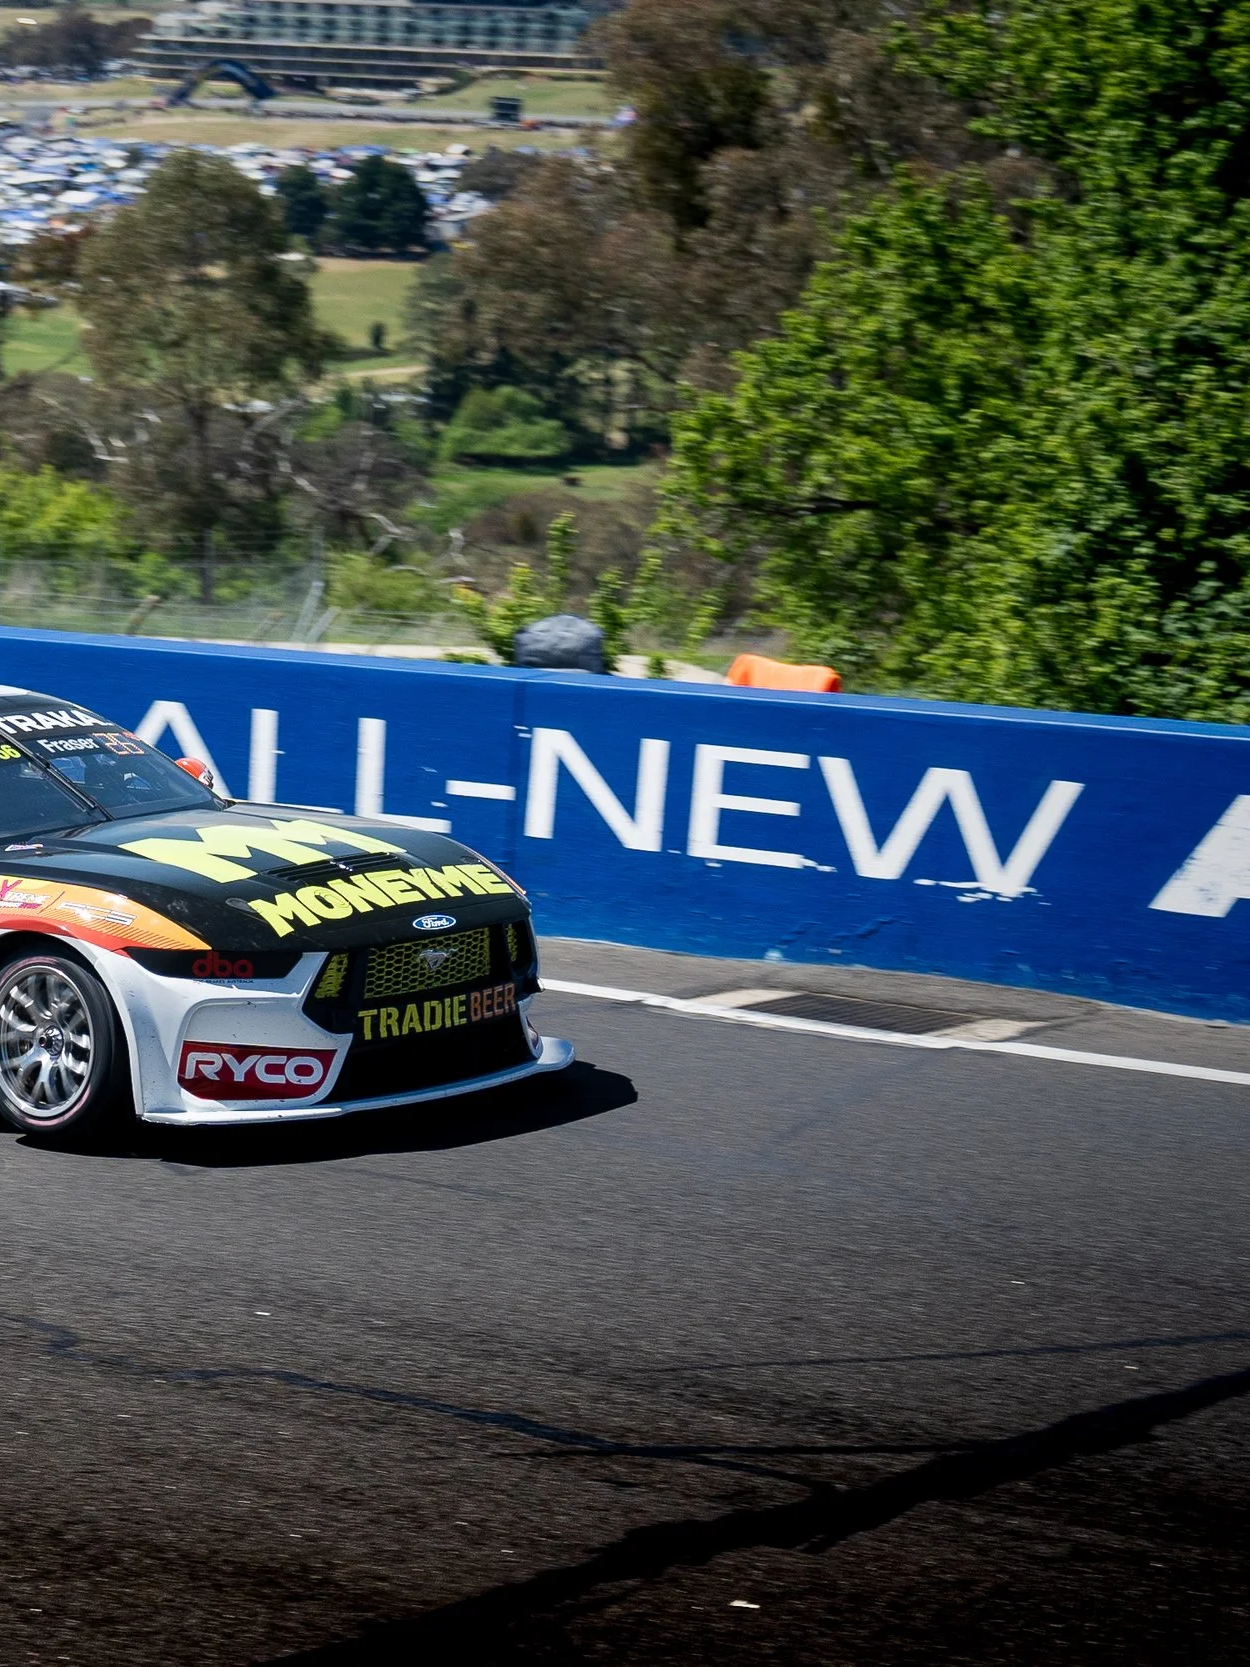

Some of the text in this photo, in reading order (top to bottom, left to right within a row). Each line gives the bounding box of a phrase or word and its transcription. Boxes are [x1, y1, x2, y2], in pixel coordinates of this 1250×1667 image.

[37, 737, 100, 753] Fraser
[134, 700, 1086, 897] ALL-NEW
[247, 863, 516, 938] MONEYME
[192, 951, 254, 978] dba
[357, 982, 517, 1040] TRADIE BEER
[185, 1051, 324, 1085] RYCO
